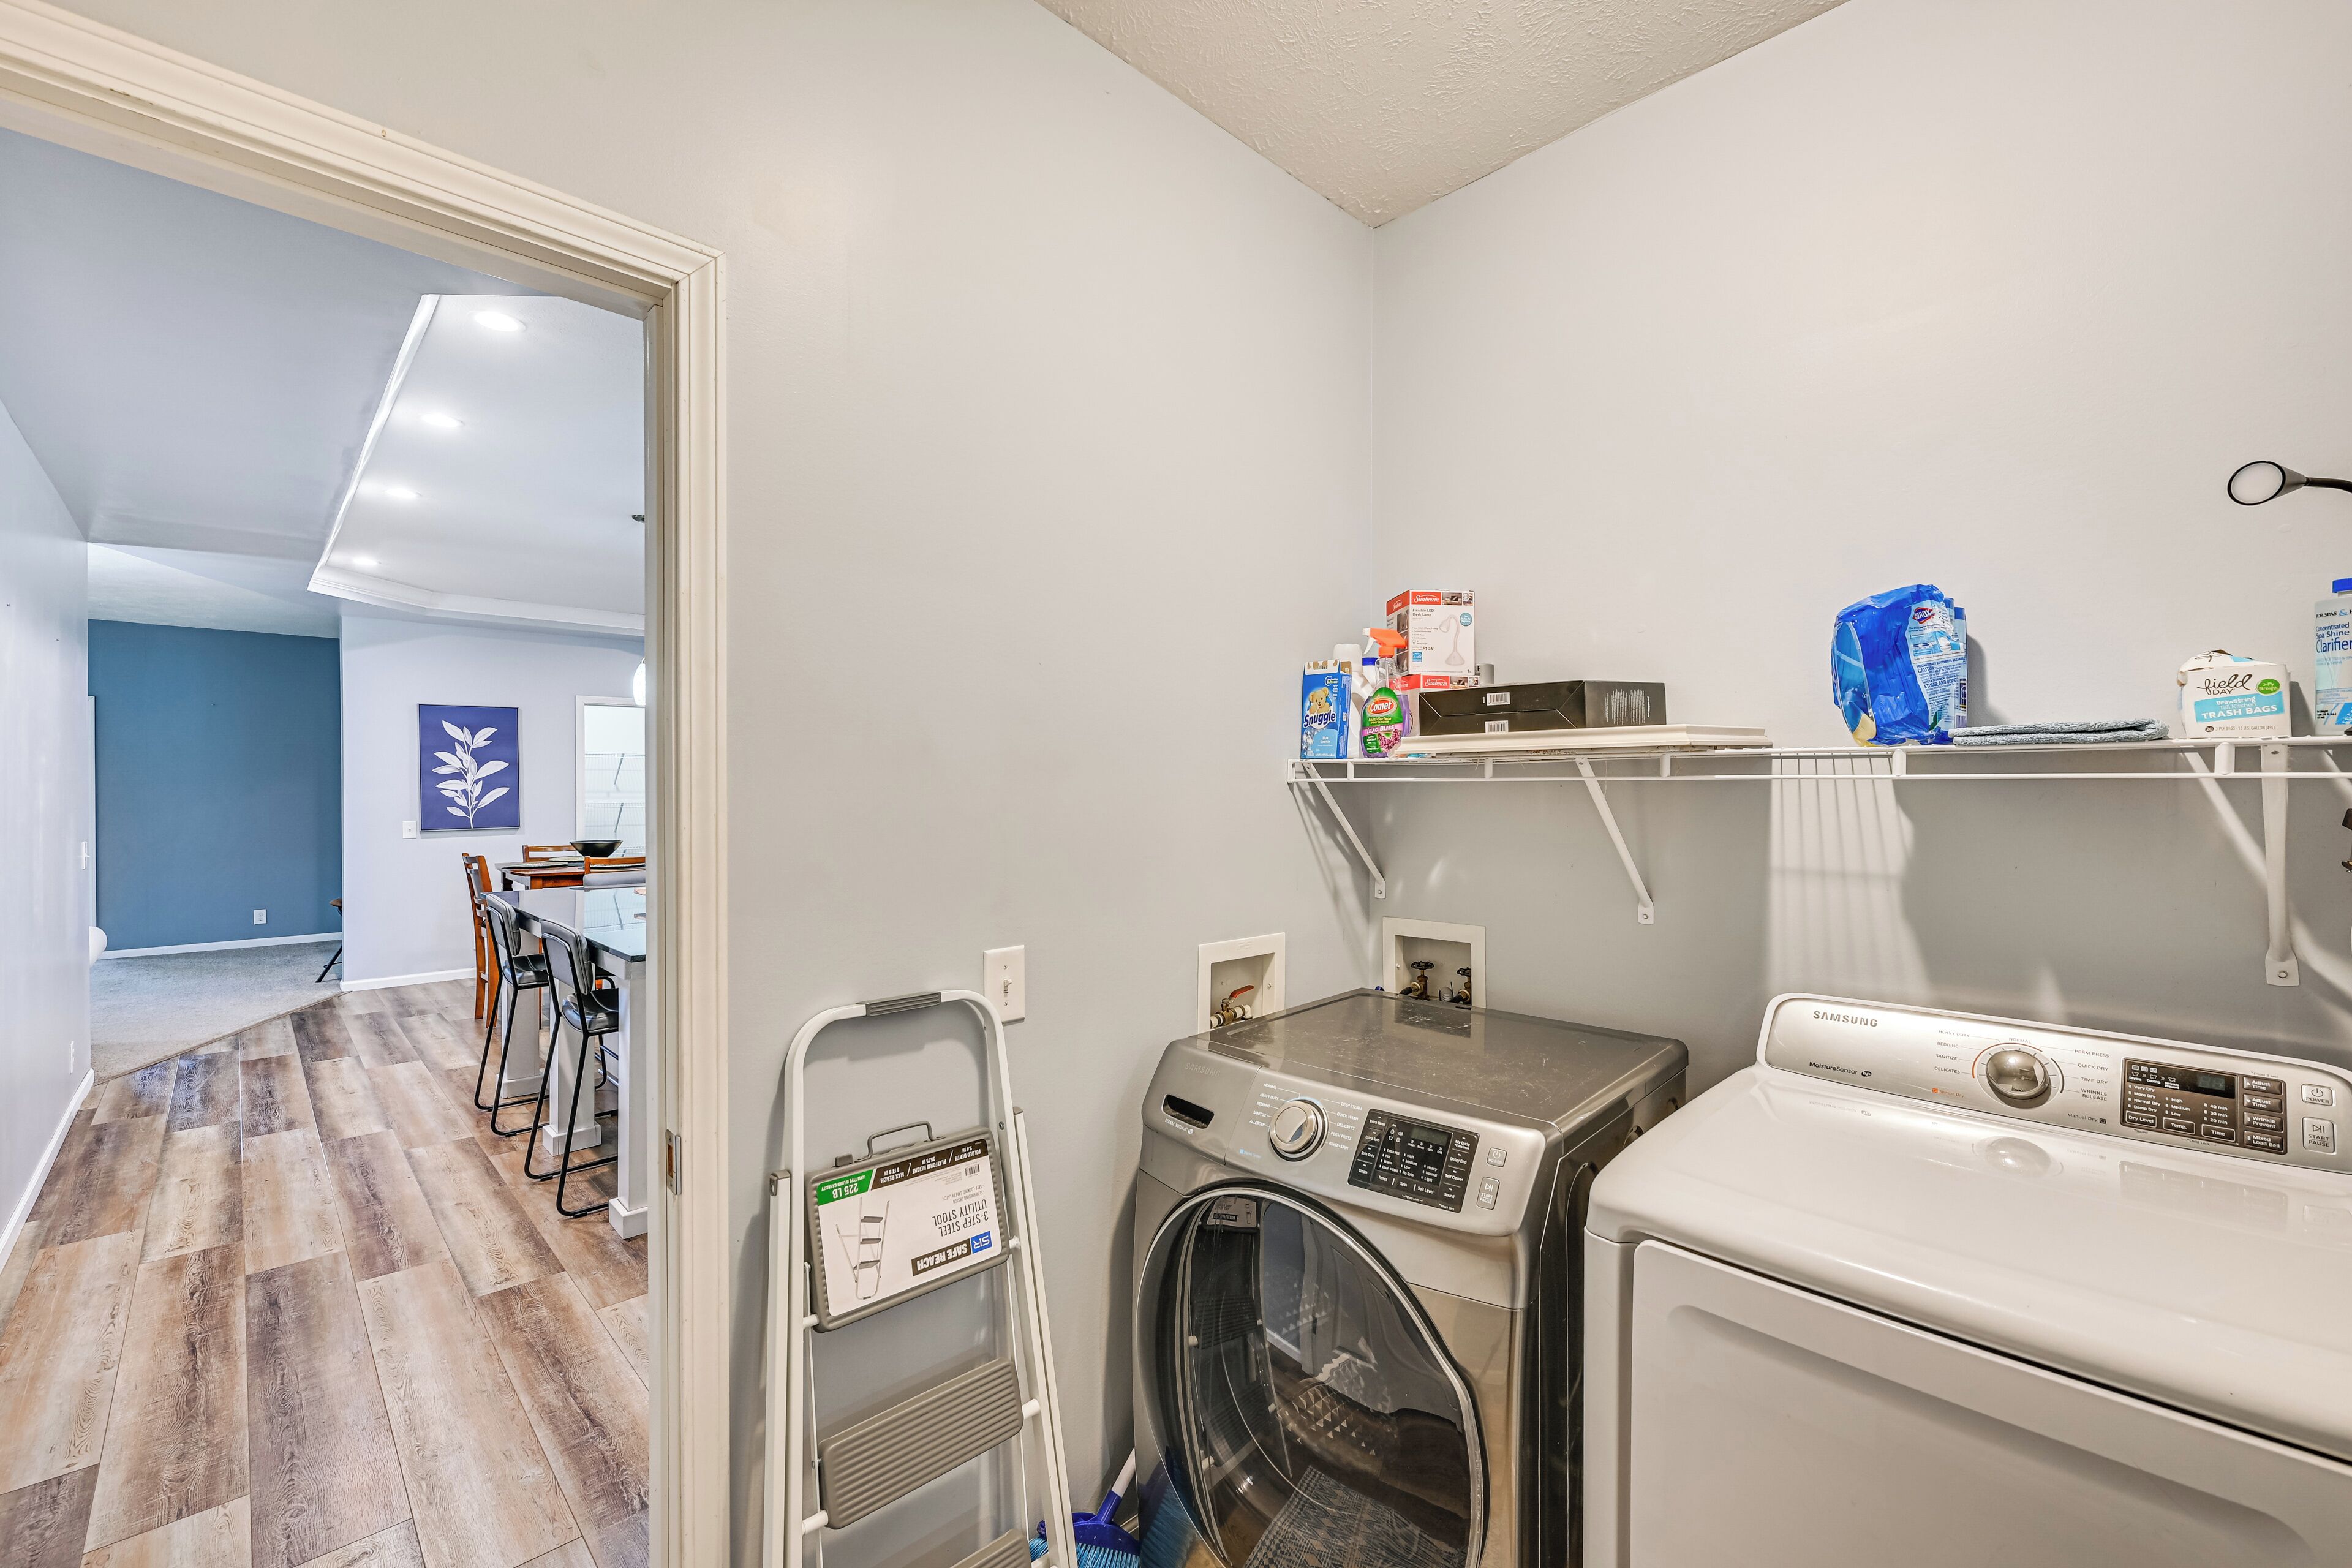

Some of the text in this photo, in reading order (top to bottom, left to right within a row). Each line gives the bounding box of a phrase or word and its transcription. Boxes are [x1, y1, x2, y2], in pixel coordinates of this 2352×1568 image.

[1414, 594, 1439, 603] Sunbeam
[2316, 622, 2350, 632] Concentrated
[2196, 674, 2253, 695] field
[1370, 700, 1392, 712] Comet
[2216, 696, 2256, 706] Drawstring
[2201, 705, 2278, 719] TRASH BAGS
[1303, 710, 1336, 729] Snuggle
[1813, 1011, 1878, 1027] SAMSUNG
[1185, 1063, 1221, 1077] SAMSUNG
[1809, 1061, 1858, 1075] MoistureSensor
[1934, 1066, 1961, 1074] DELICATES
[1165, 1118, 1175, 1127] STEAM
[1336, 1122, 1355, 1131] DELICATES
[1329, 1141, 1349, 1150] RINSE+SPIN
[954, 1149, 981, 1161] FOLDED DEPTH
[912, 1159, 947, 1174] PLATFORM HEIGHT
[880, 1174, 895, 1183] REACH
[821, 1182, 837, 1191] CAPACITY
[832, 1183, 859, 1199] 225 LB
[932, 1199, 987, 1227] UTILITY STOOL
[938, 1210, 989, 1237] 3-STEP STEEL
[916, 1243, 968, 1271] SAFE REACH
